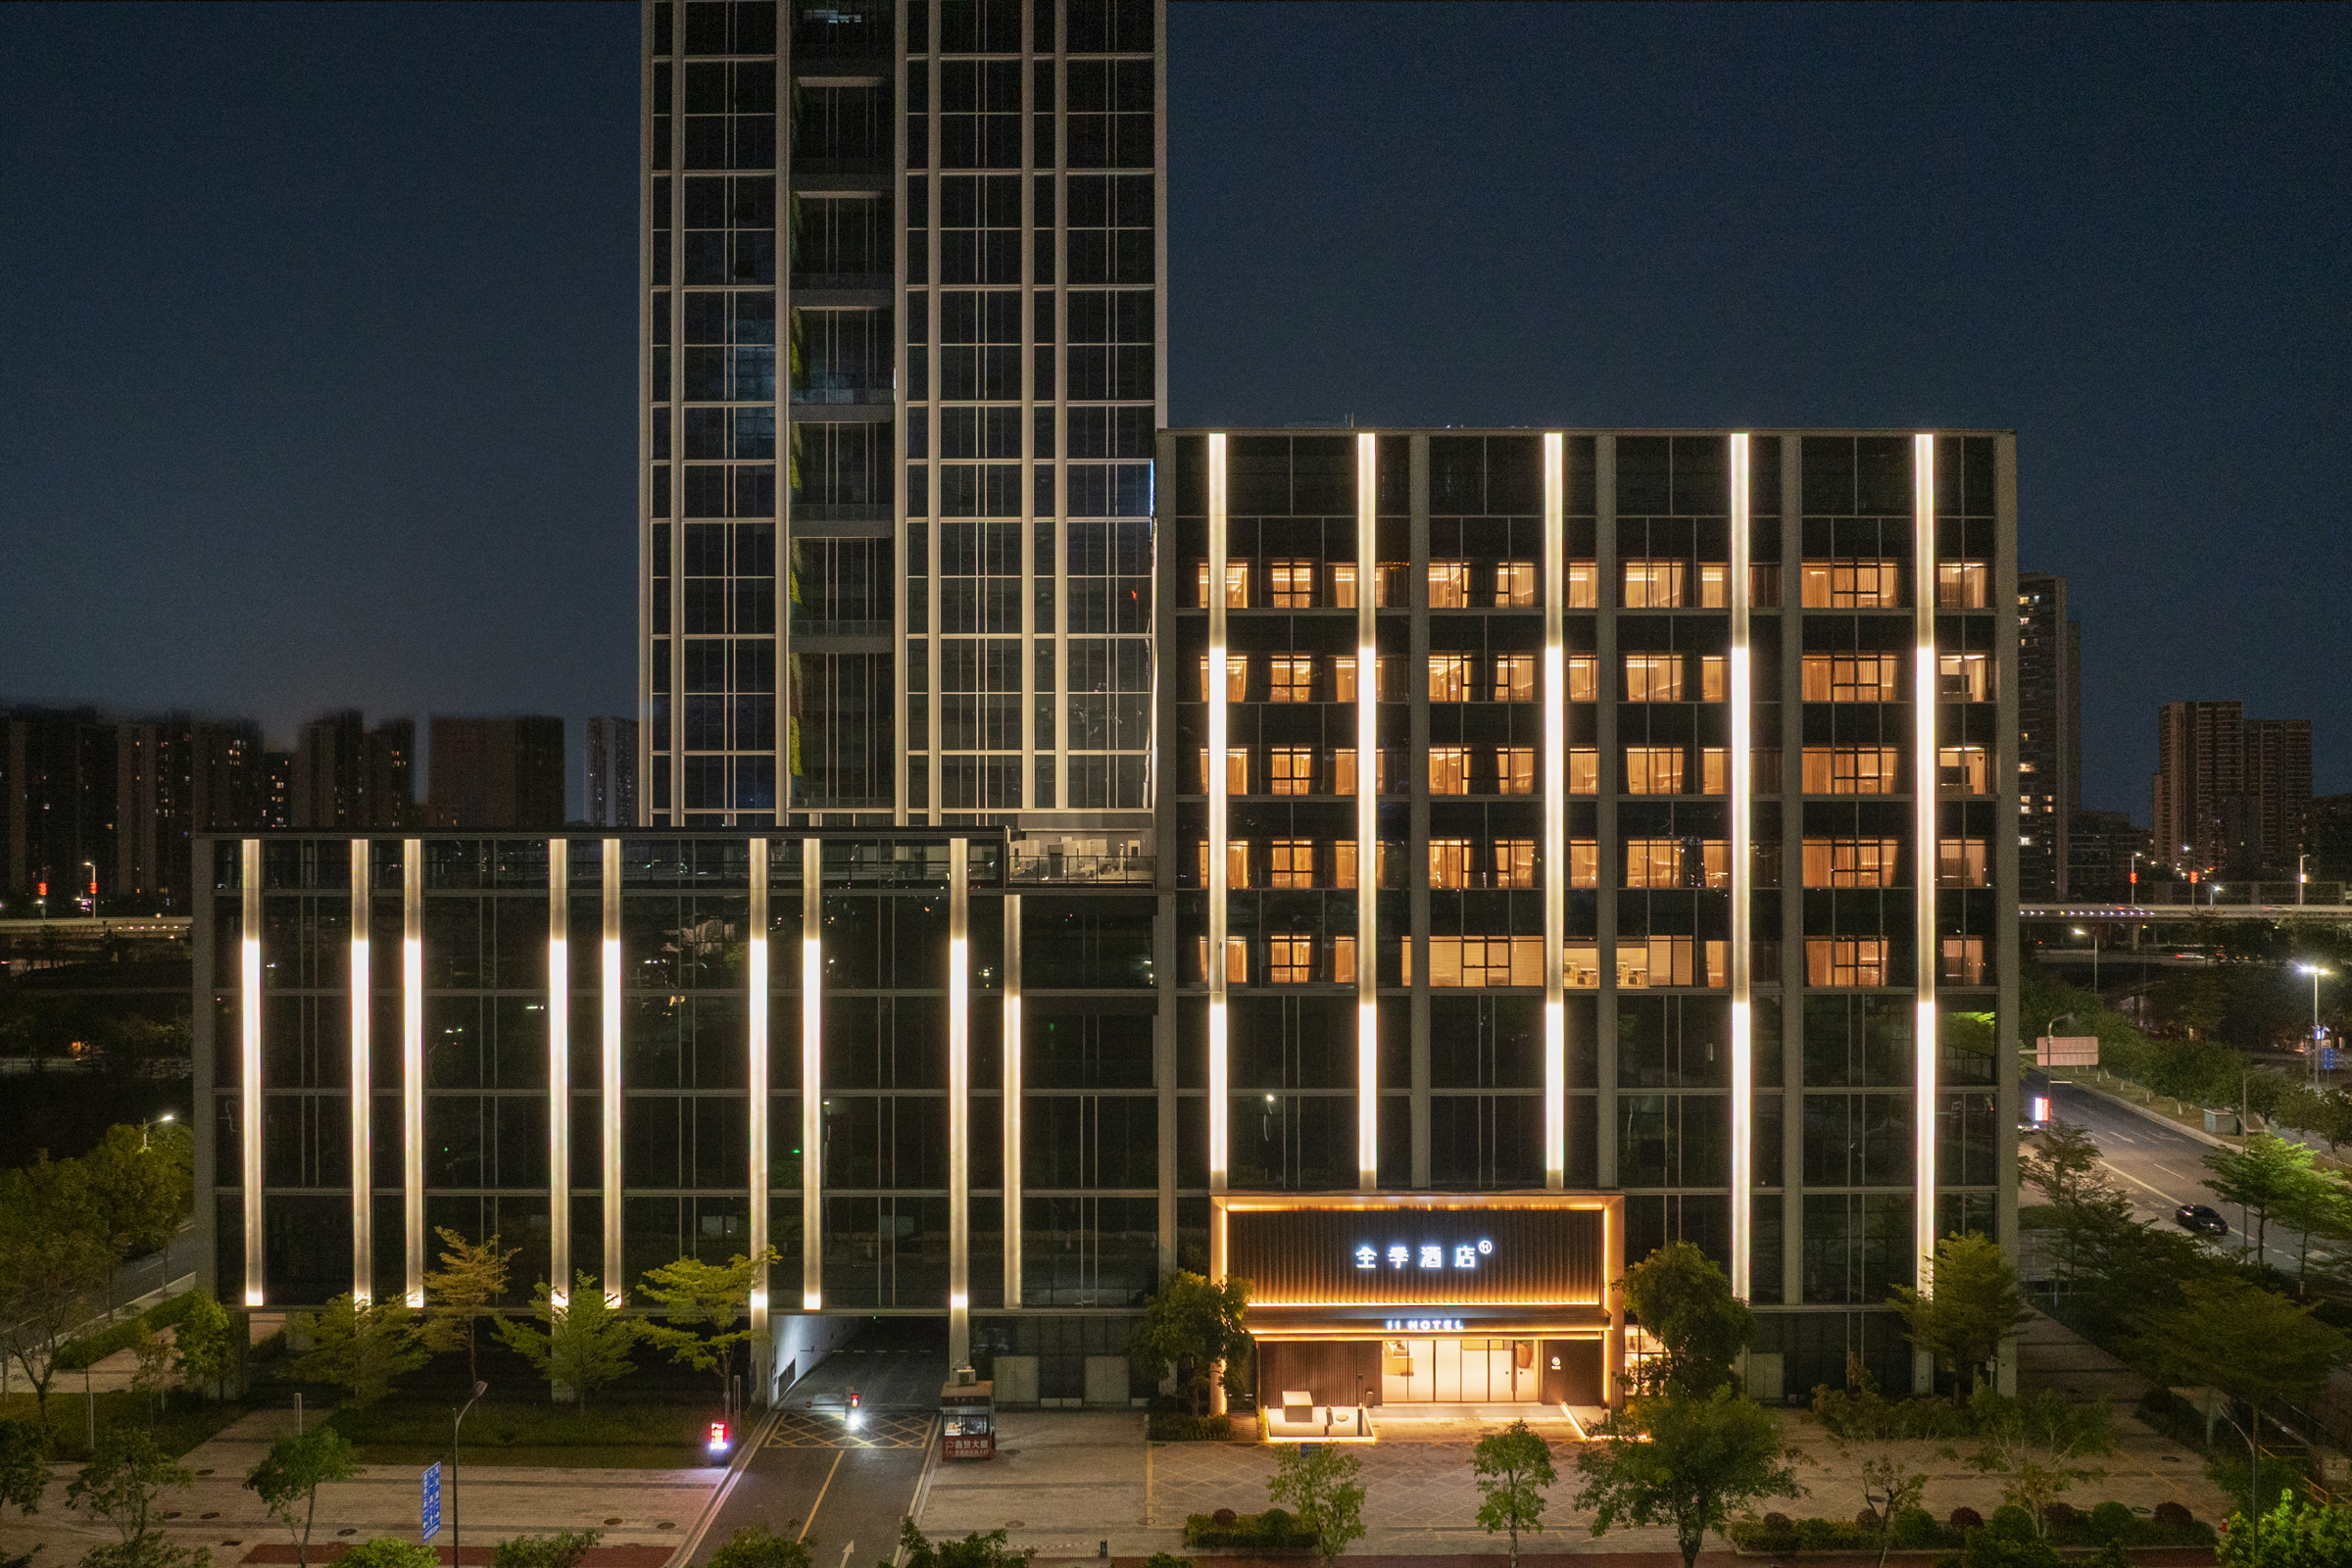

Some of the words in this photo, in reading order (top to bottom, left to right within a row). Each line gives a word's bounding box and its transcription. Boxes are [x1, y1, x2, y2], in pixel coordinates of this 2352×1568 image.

[1355, 1246, 1475, 1268] 全季酒店
[1407, 1320, 1463, 1331] HOTEL
